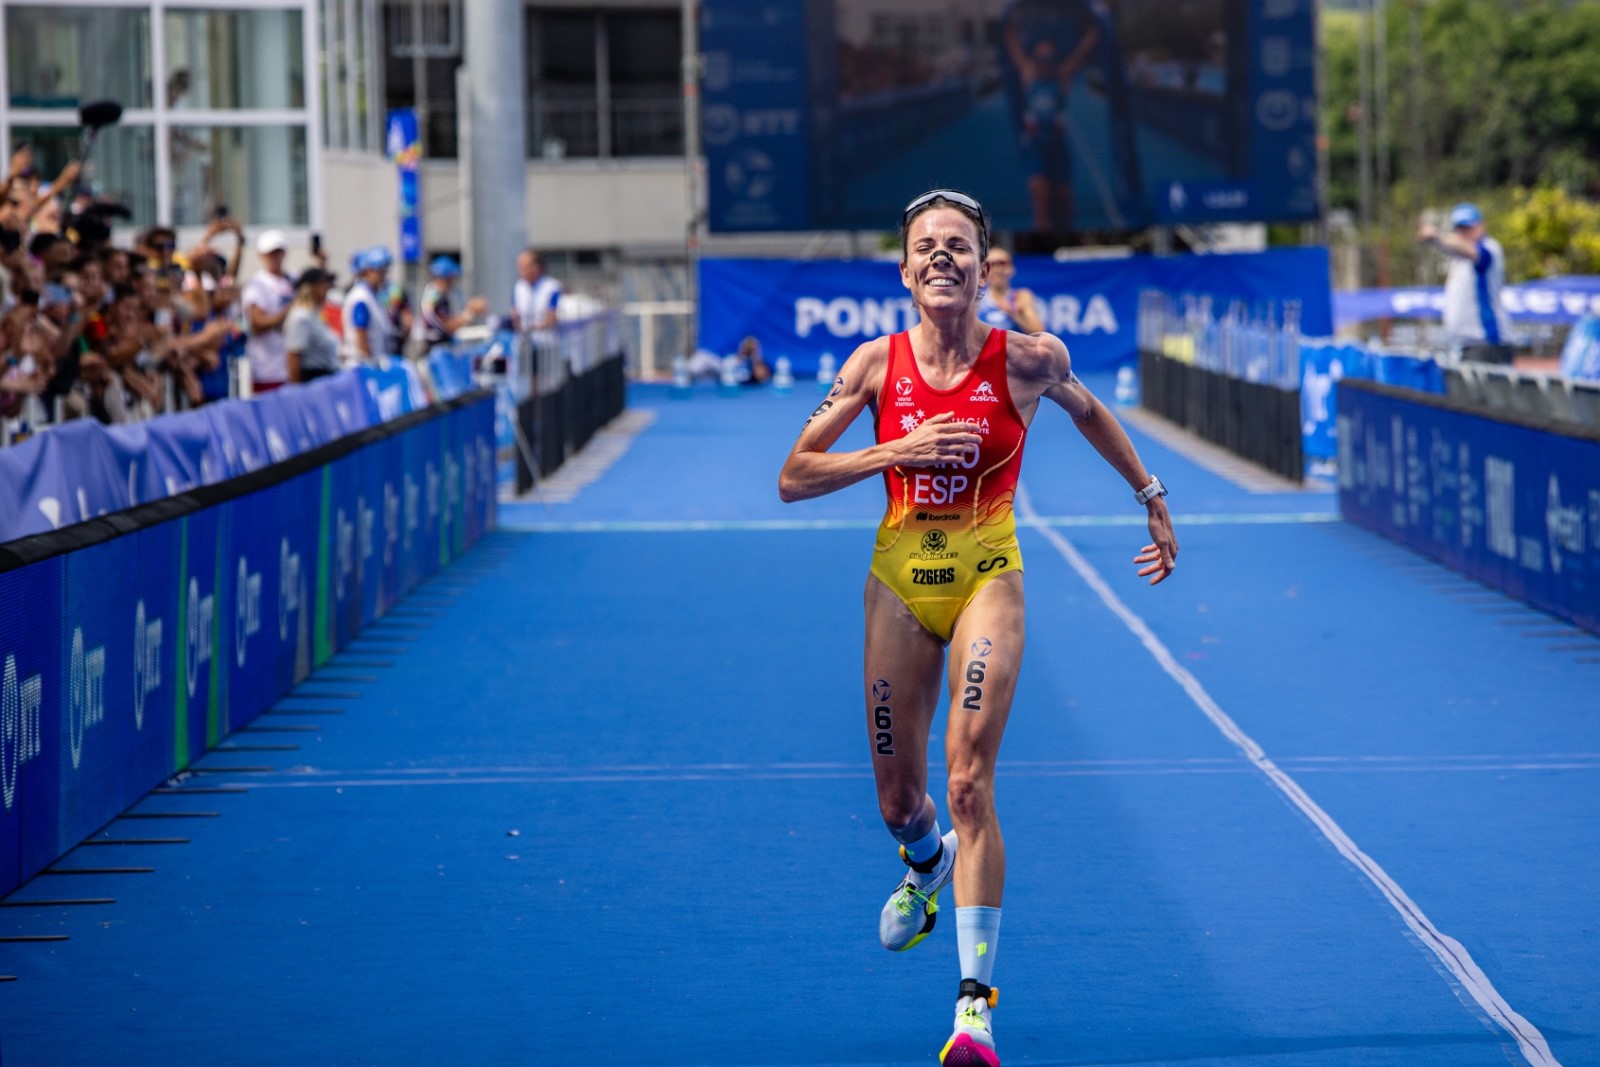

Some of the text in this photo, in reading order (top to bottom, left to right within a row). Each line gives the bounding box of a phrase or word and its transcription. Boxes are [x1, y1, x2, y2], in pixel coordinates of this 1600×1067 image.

[795, 296, 1119, 337] PONTRA
[914, 474, 968, 505] ESP
[912, 567, 955, 585] 226ERS
